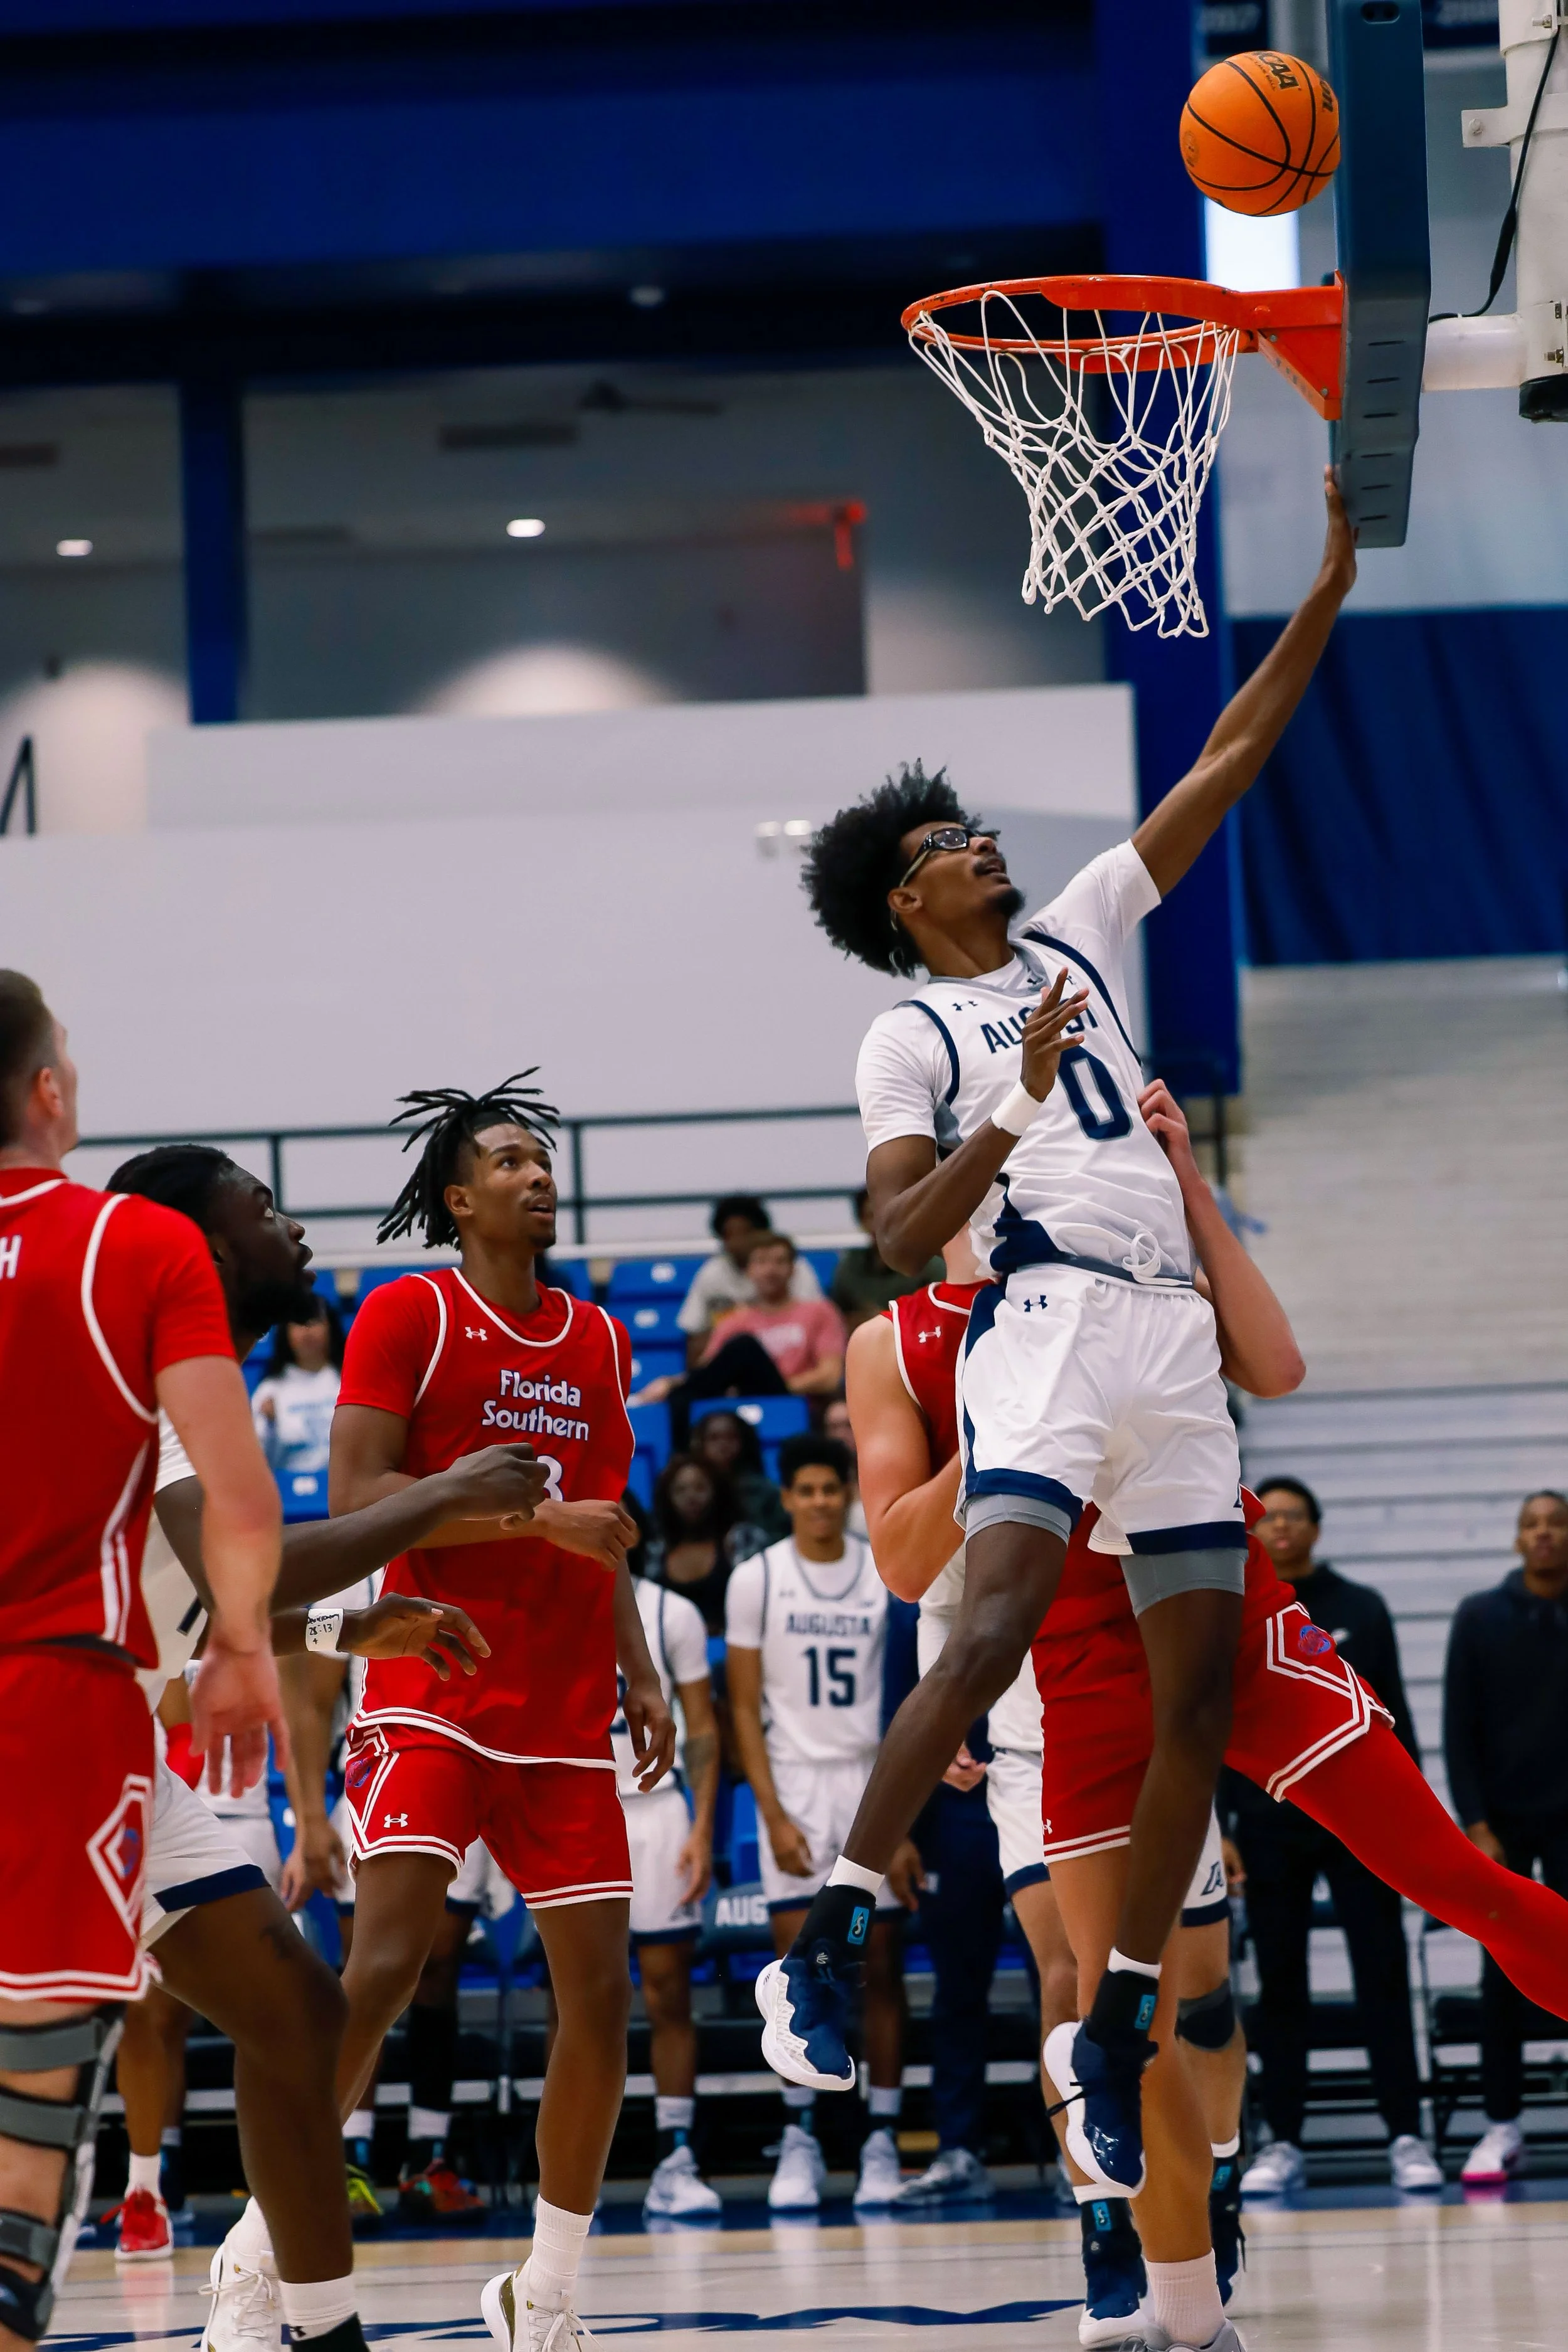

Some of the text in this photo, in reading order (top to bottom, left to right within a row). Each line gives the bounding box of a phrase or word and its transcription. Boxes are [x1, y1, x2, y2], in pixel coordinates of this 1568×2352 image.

[1057, 1044, 1134, 1142] 0
[500, 1368, 581, 1408] Florida
[481, 1399, 590, 1441] Southern
[786, 1613, 871, 1636] AUGUSTA
[801, 1645, 857, 1708] 15
